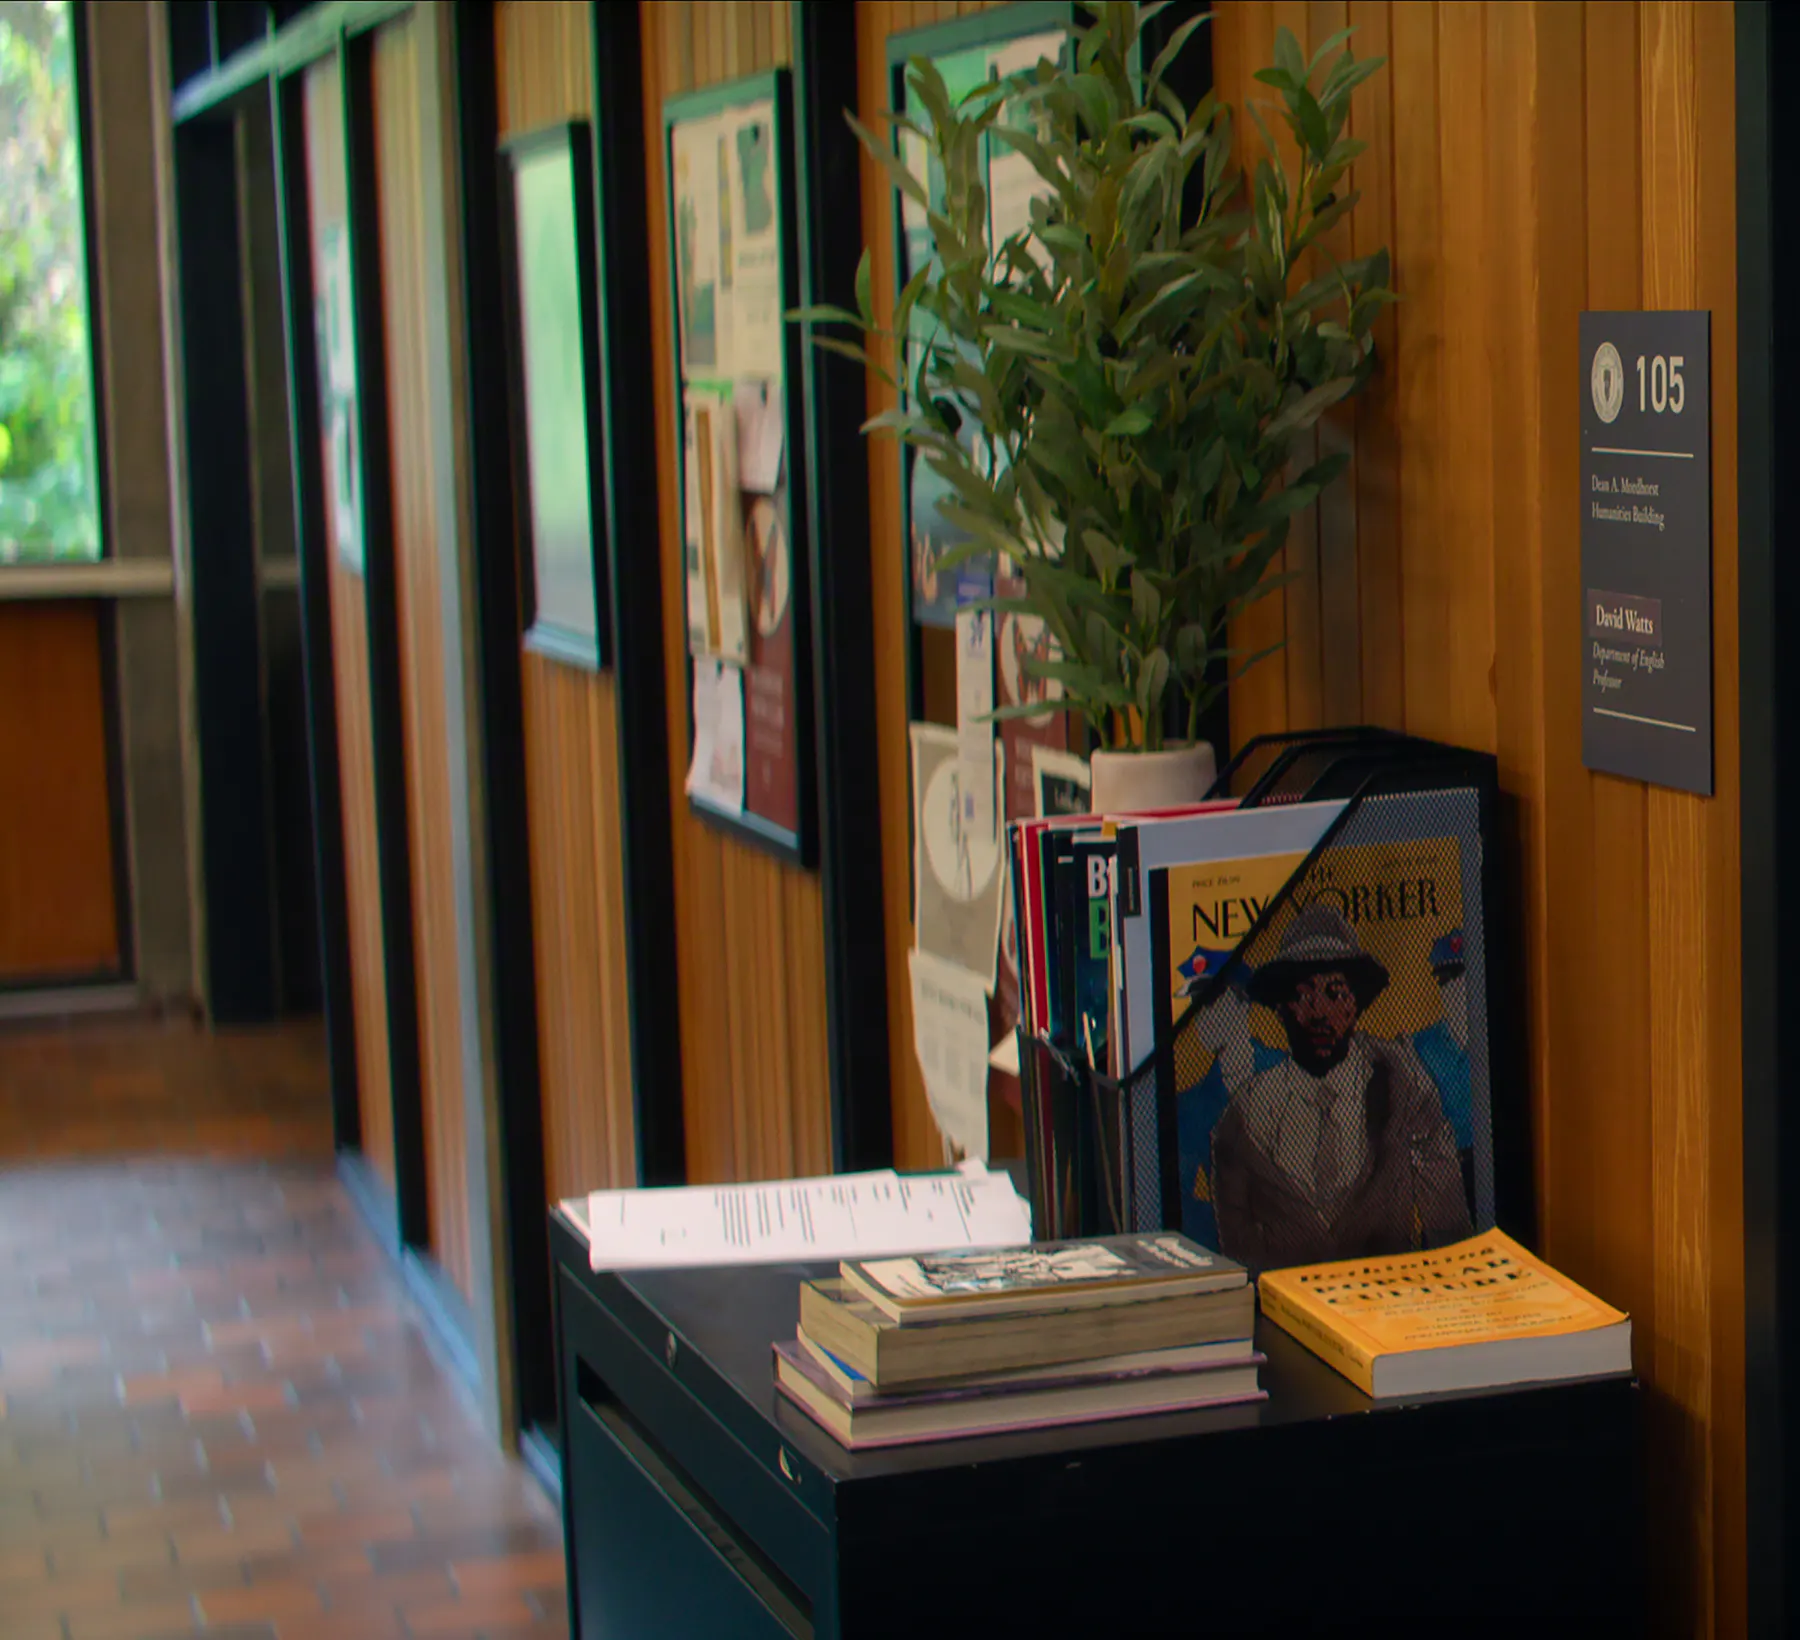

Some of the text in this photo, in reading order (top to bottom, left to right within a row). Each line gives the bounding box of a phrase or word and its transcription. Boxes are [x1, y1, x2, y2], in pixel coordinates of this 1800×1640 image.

[1636, 355, 1685, 414] 105
[1592, 473, 1609, 492] Dean
[1611, 476, 1620, 493] A.
[1591, 501, 1665, 532] Humanities Building
[1596, 604, 1654, 634] David Watts
[1593, 641, 1665, 674] Department of English
[1593, 668, 1623, 693] Professor
[1192, 877, 1439, 943] NEW YORKER
[1313, 1257, 1512, 1295] POPULAR
[1327, 1267, 1533, 1306] CULTURE
